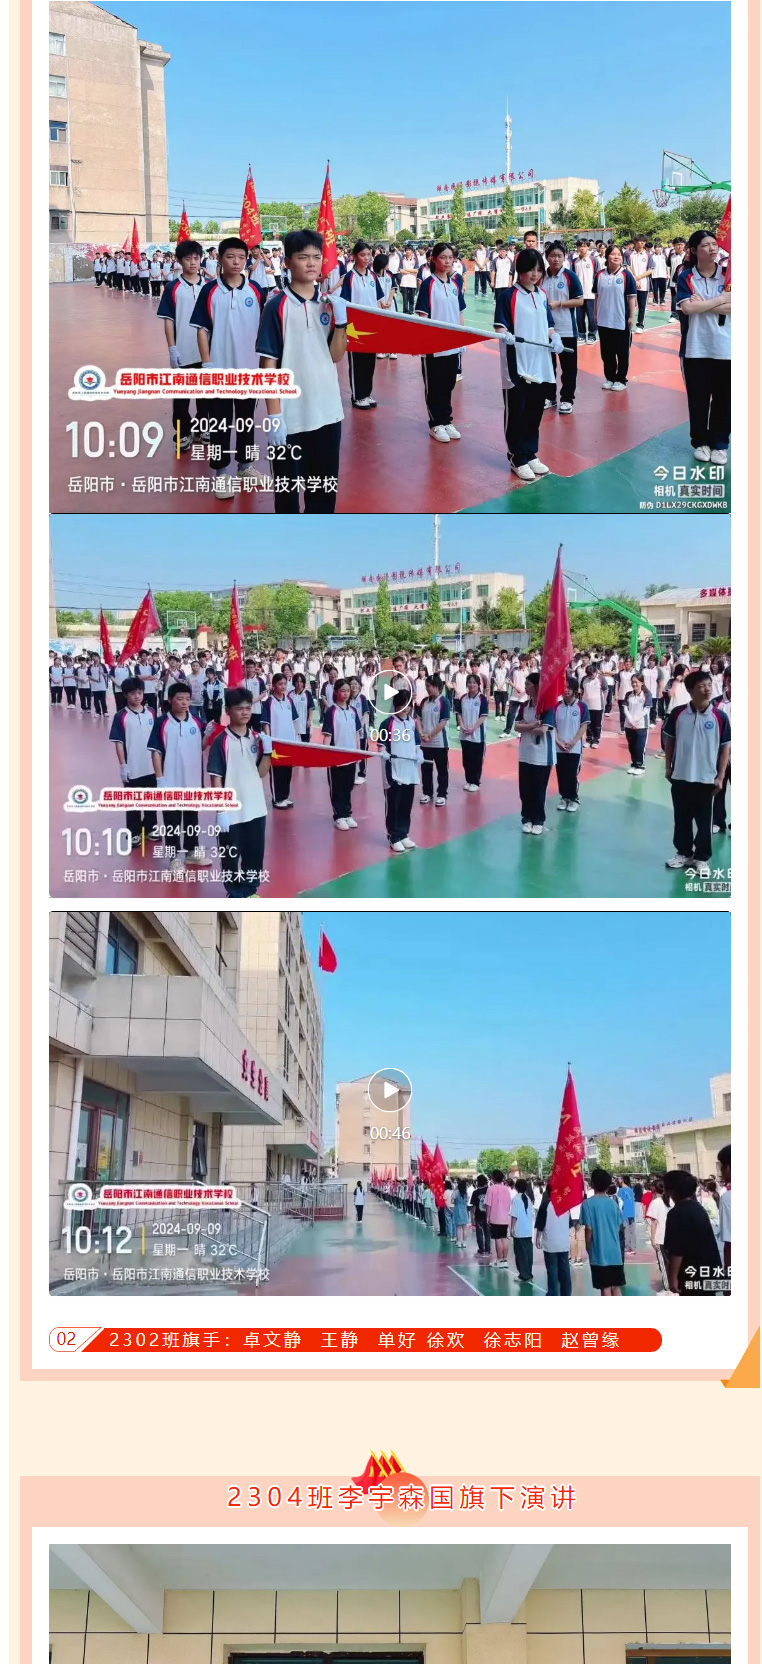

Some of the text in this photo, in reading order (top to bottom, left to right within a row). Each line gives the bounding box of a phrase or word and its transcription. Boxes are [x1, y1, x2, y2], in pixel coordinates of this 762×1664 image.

[56, 1332, 77, 1346] 02
[321, 1331, 358, 1348] 王静
[378, 1332, 416, 1348] 单好
[426, 1332, 464, 1348] 徐欢
[484, 1332, 541, 1348] 徐志阳
[561, 1332, 619, 1348] 赵曾缘
[227, 1484, 577, 1511] 2304班李宇森国旗下演讲
